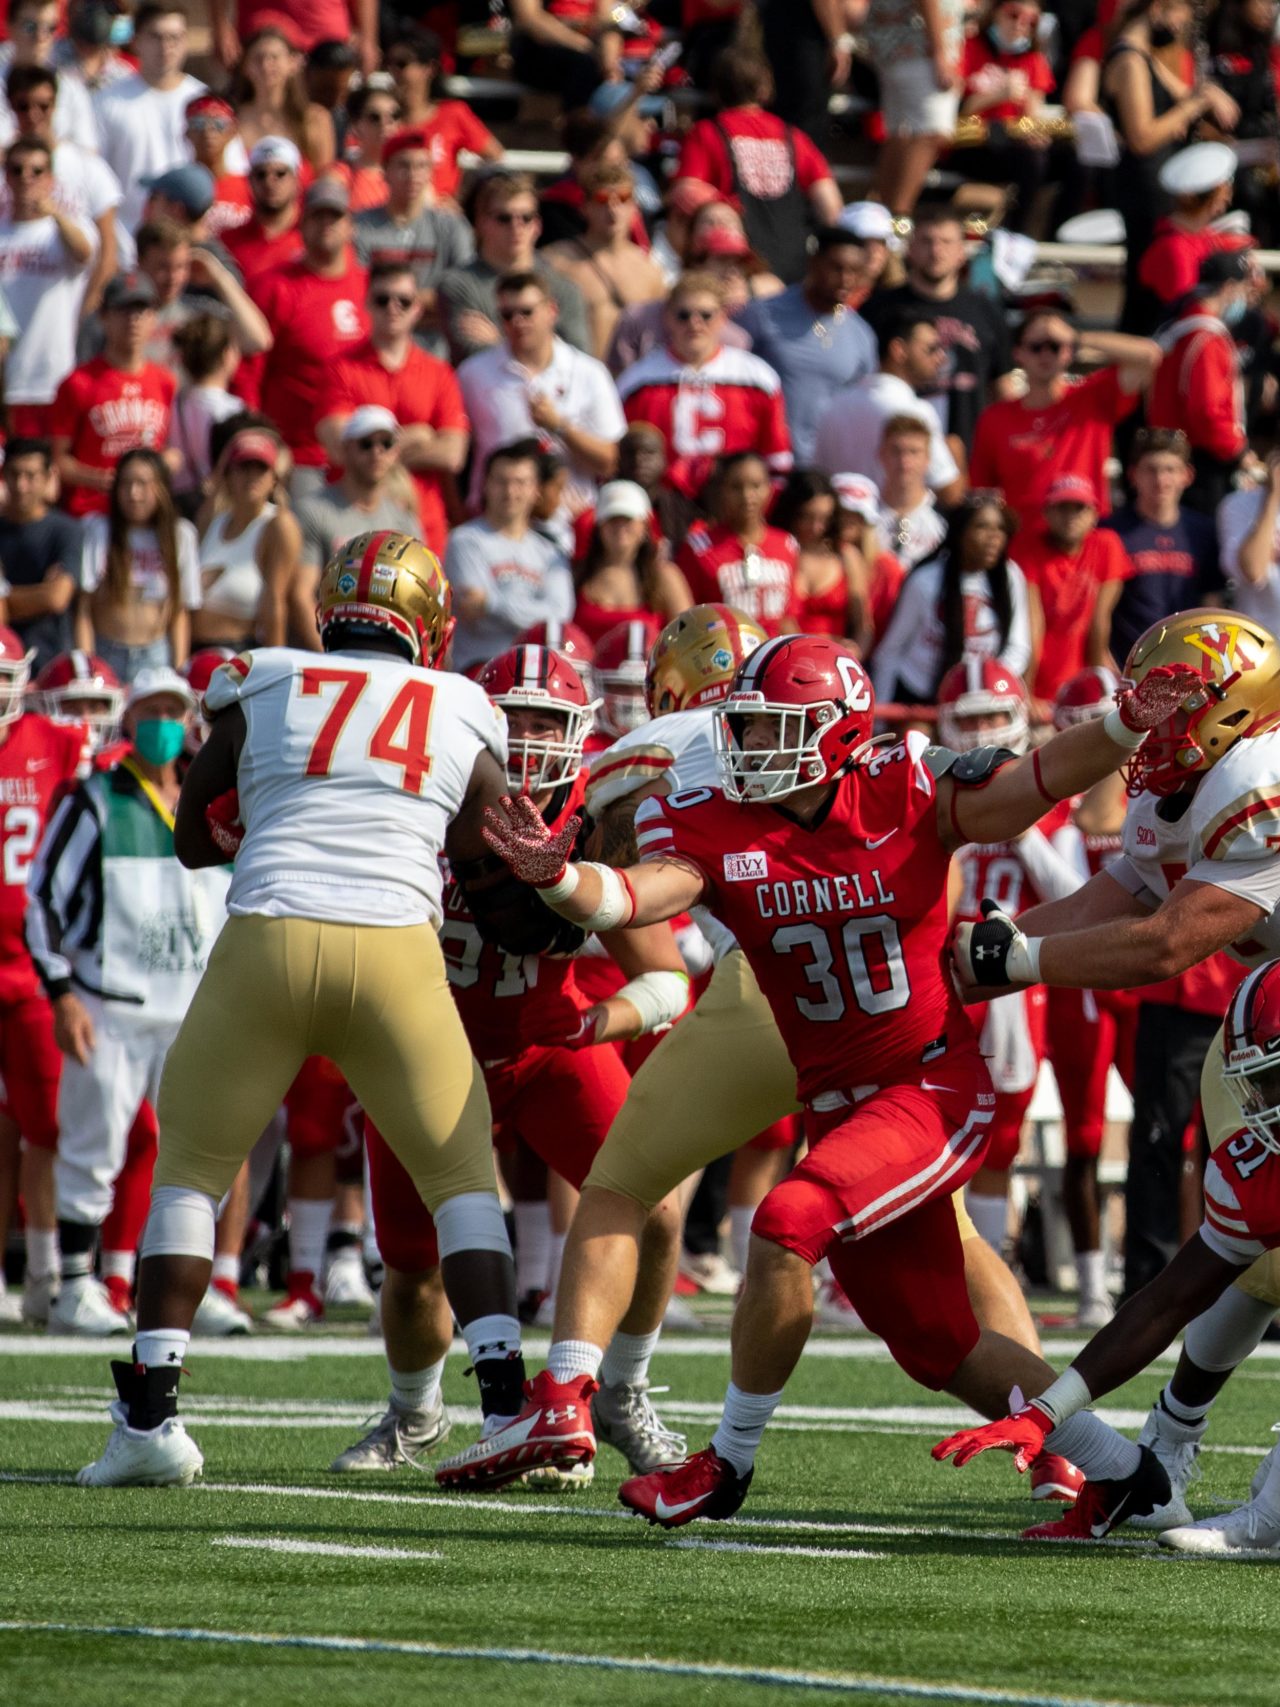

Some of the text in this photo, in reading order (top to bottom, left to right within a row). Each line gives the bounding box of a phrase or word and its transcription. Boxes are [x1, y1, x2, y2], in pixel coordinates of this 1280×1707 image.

[674, 394, 726, 457] C
[731, 693, 758, 701] Riddell
[836, 656, 871, 711] C
[298, 667, 437, 797] 74
[736, 858, 763, 872] IVY
[738, 870, 765, 878] LEAGUE
[756, 869, 895, 919] CORNELL
[770, 914, 911, 1021] 30
[1230, 1049, 1257, 1062] Riddell
